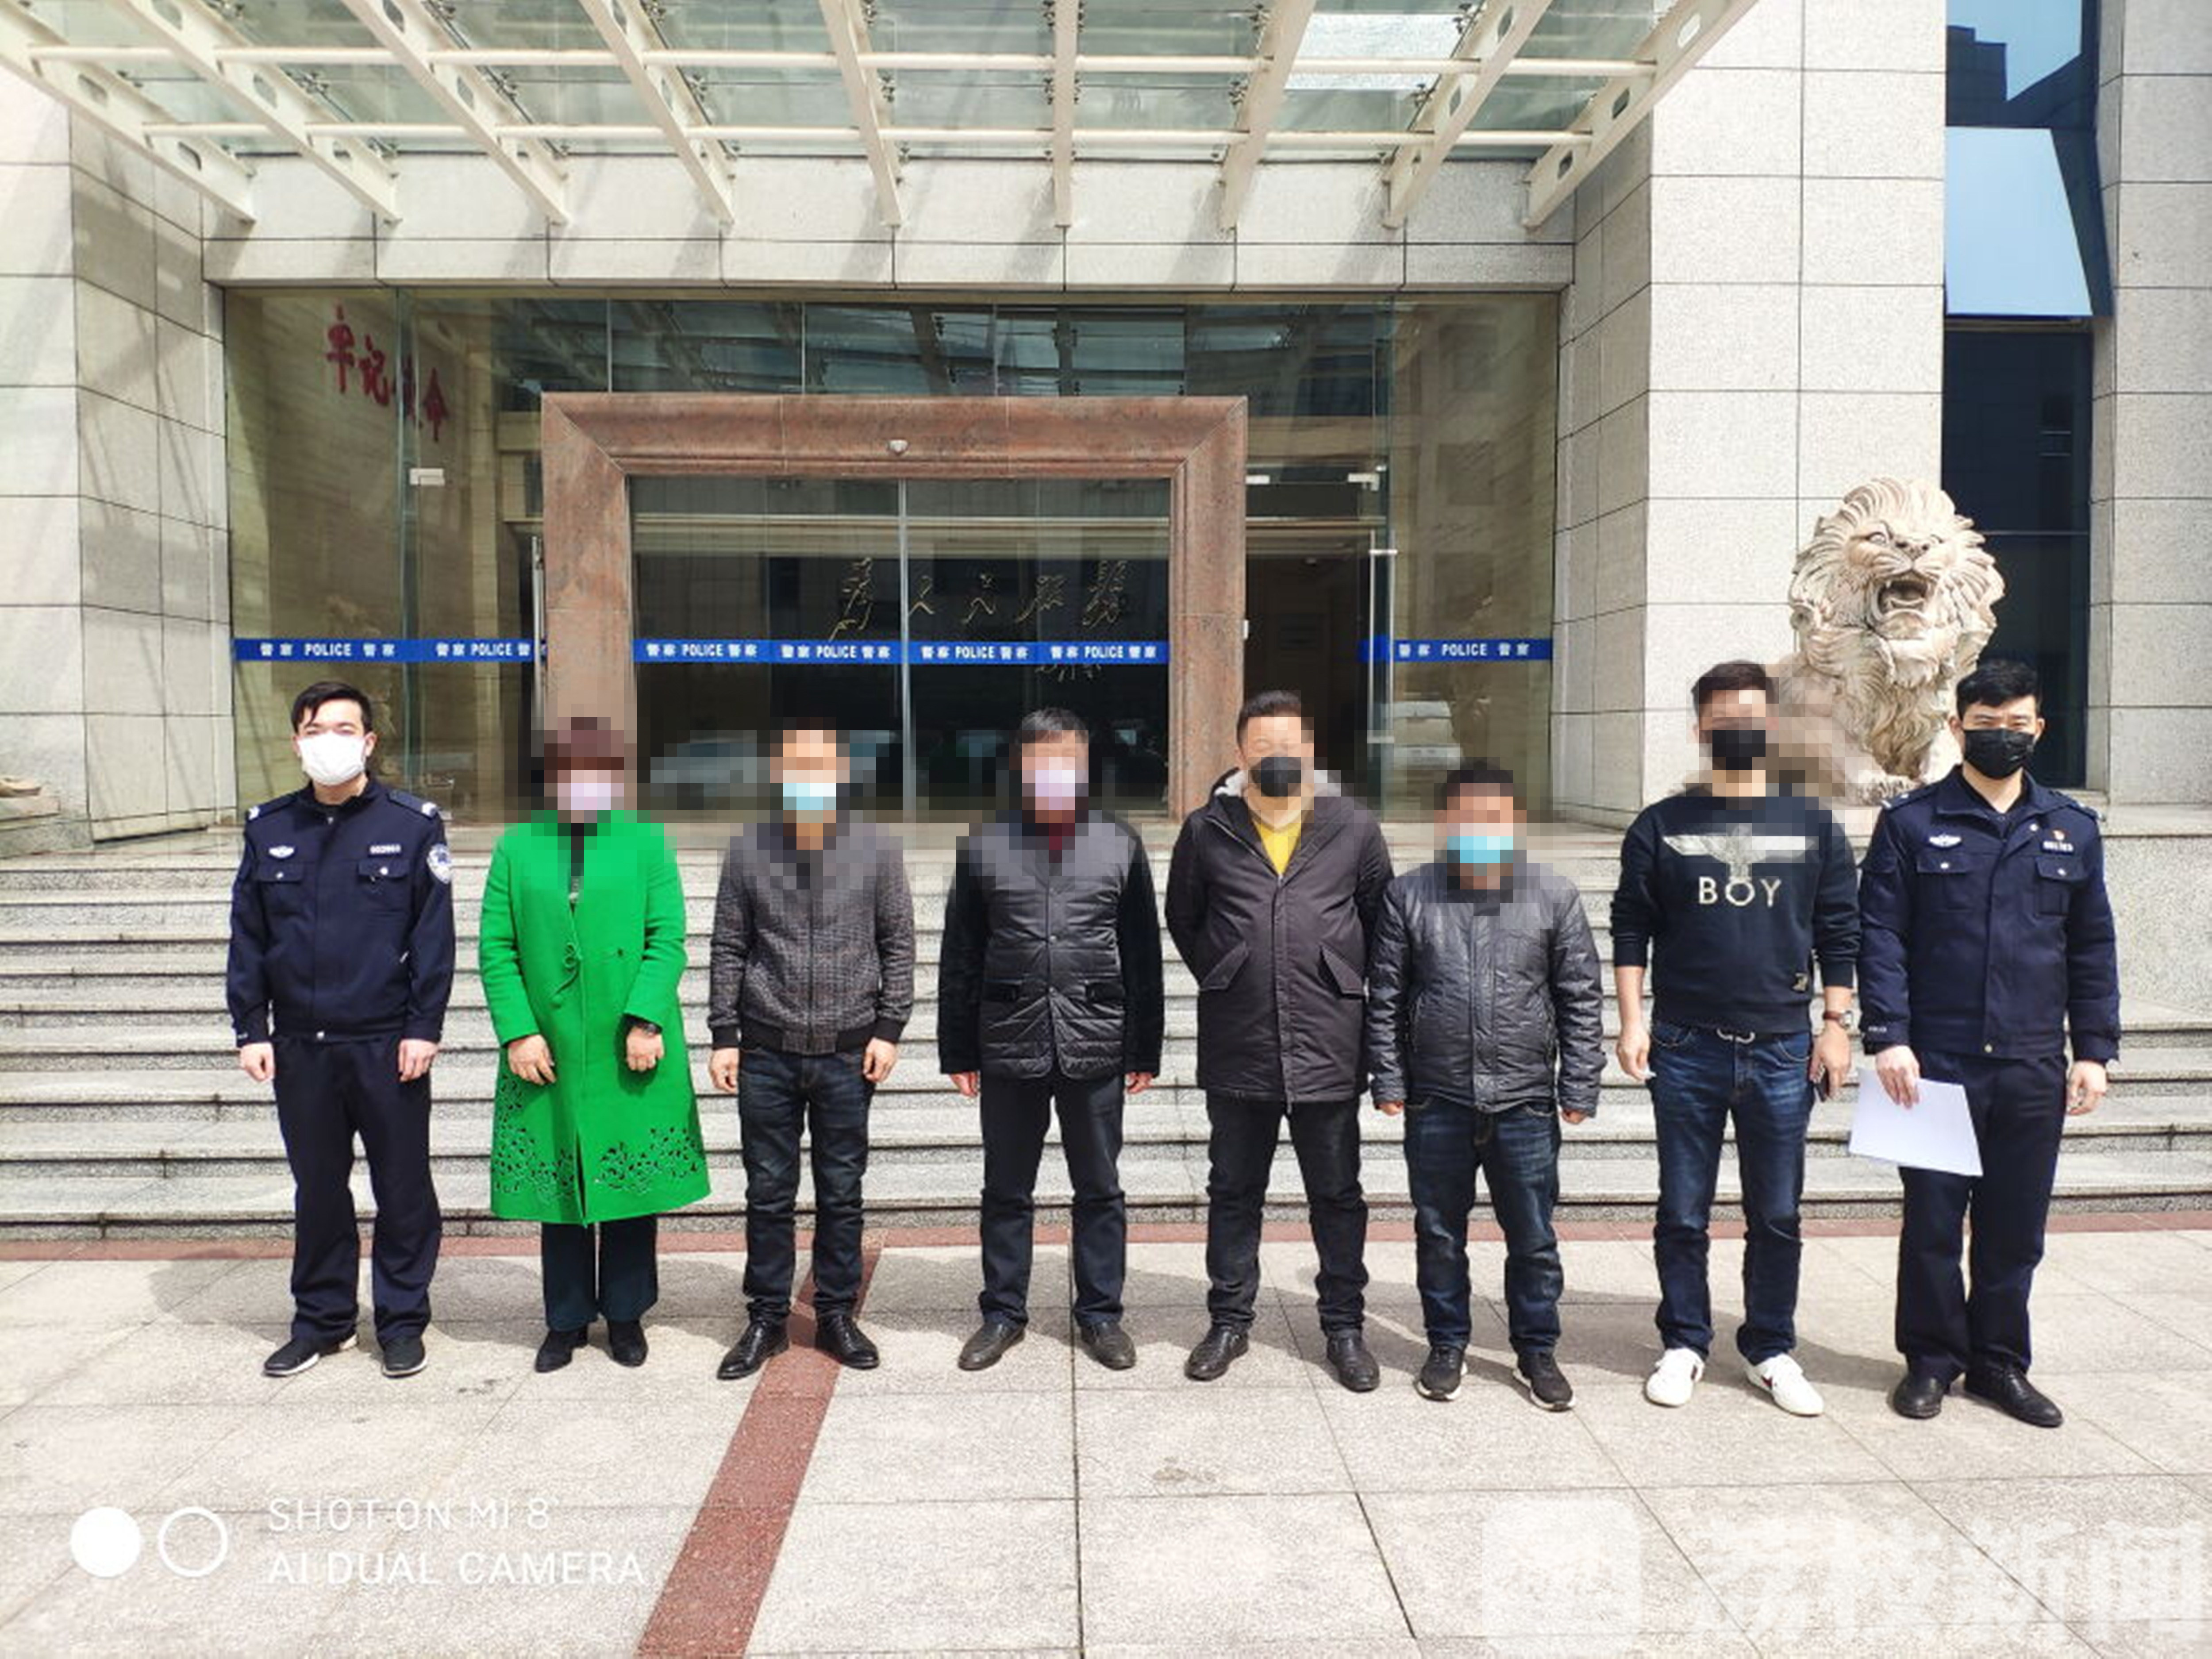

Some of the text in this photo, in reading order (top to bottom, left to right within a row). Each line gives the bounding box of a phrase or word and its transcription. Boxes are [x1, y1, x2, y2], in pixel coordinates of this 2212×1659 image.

[305, 643, 351, 656] POLICE
[471, 643, 512, 656] POLICE
[681, 644, 723, 657] POLICE
[816, 645, 856, 658] POLICE
[955, 646, 995, 659] POLICE
[1085, 646, 1123, 658] POLICE
[1442, 643, 1486, 656] POLICE
[1698, 876, 1782, 907] BOY
